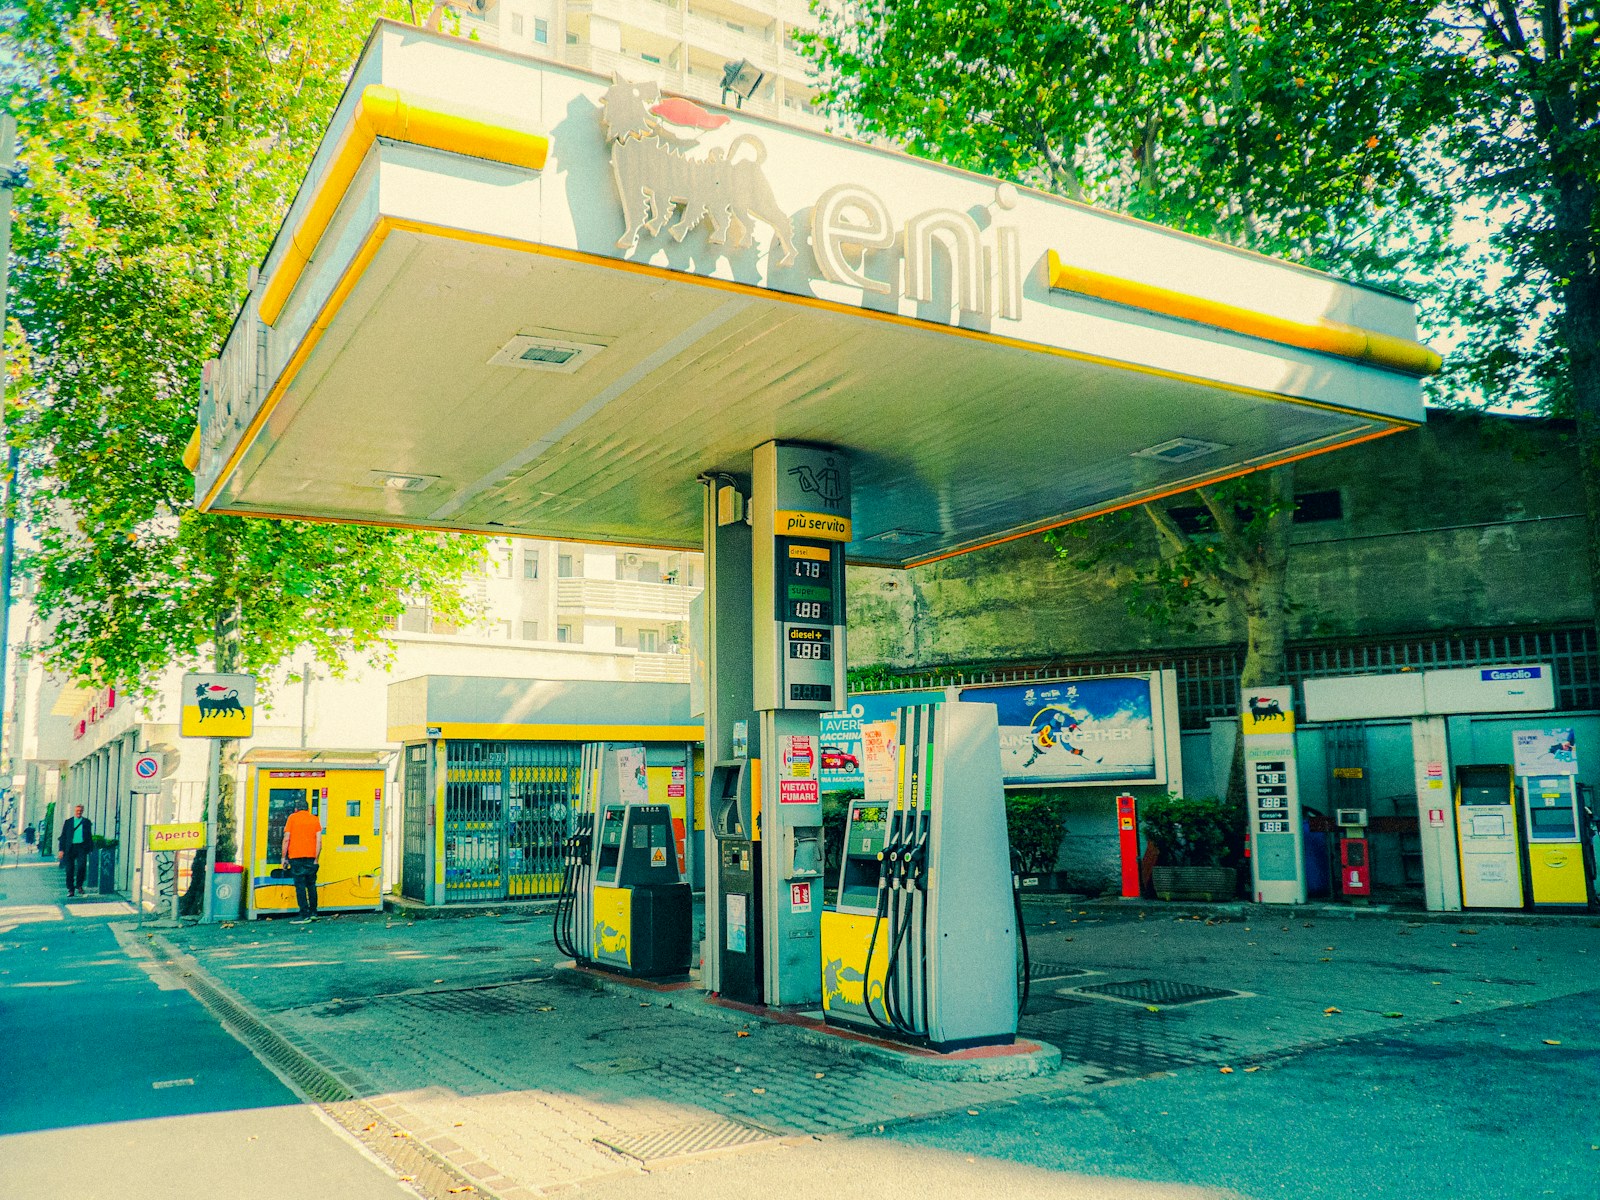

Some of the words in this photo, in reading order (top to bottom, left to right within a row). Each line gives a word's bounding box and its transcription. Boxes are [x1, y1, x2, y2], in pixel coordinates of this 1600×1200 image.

[811, 182, 1022, 321] eni
[787, 513, 805, 530] più
[808, 517, 845, 533] servito
[795, 561, 820, 578] 1.78
[791, 586, 814, 596] super
[795, 602, 821, 618] 1.88
[796, 643, 822, 659] 1.88
[1490, 669, 1532, 680] Gasolio
[1038, 725, 1056, 746] &
[1054, 728, 1132, 744] TOGETHER
[781, 783, 816, 791] VIETATO
[781, 792, 816, 801] FUMARE
[155, 830, 200, 842] Aperto
